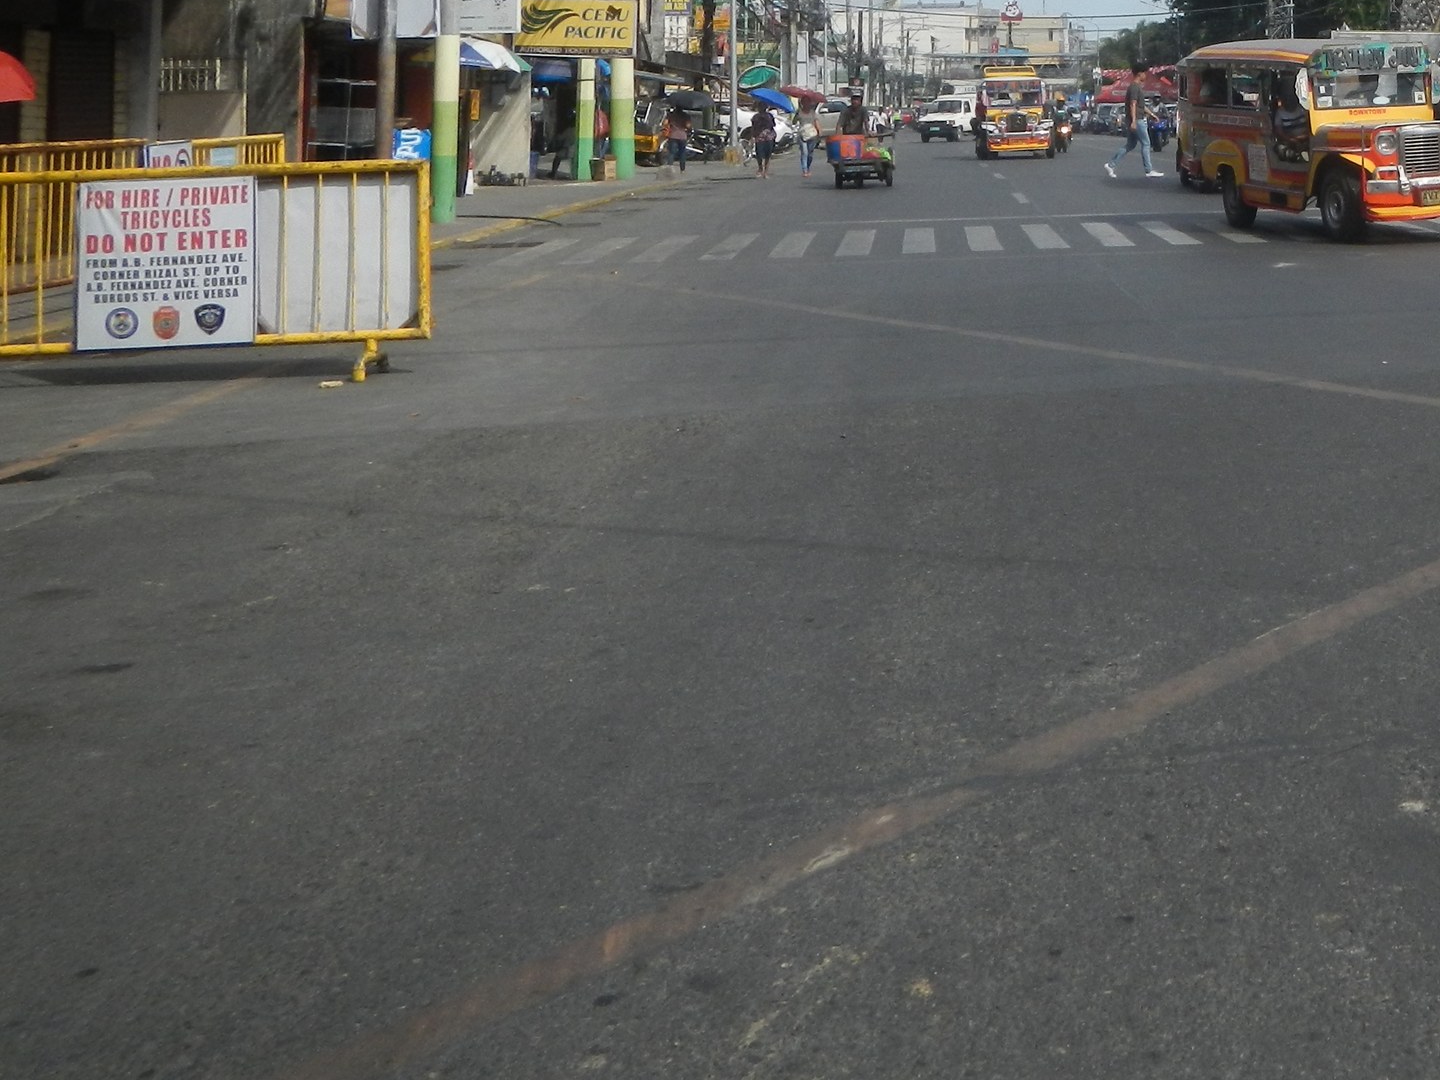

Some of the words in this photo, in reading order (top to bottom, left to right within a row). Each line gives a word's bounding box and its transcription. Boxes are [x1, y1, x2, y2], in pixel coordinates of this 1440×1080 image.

[564, 26, 629, 39] PACIFIC
[86, 190, 114, 210] FOR
[121, 188, 160, 209] HIRE
[166, 187, 174, 207] /
[180, 184, 249, 206] PRIVATE
[120, 208, 211, 230] TRICYCLES
[86, 234, 114, 255] DO
[124, 232, 168, 253] NOT
[177, 229, 248, 251] ENTER
[86, 258, 118, 269] FROM
[122, 257, 145, 268] A.B.
[150, 254, 217, 267] FERNANDEZ
[221, 252, 248, 263] AVE.
[93, 270, 140, 281] CORNER
[145, 267, 178, 278] RIZAL
[182, 267, 200, 277] ST.
[204, 266, 220, 276] UP
[225, 265, 240, 275] TO
[86, 282, 107, 292] A.B.
[110, 279, 172, 291] FERNANDEZ
[175, 278, 199, 289] AVE.
[203, 275, 248, 287] CORNER
[94, 292, 138, 304] BURGOS
[143, 291, 158, 302] ST.
[162, 293, 169, 301] &
[173, 289, 200, 301] VICE
[203, 288, 239, 299] VERSA
